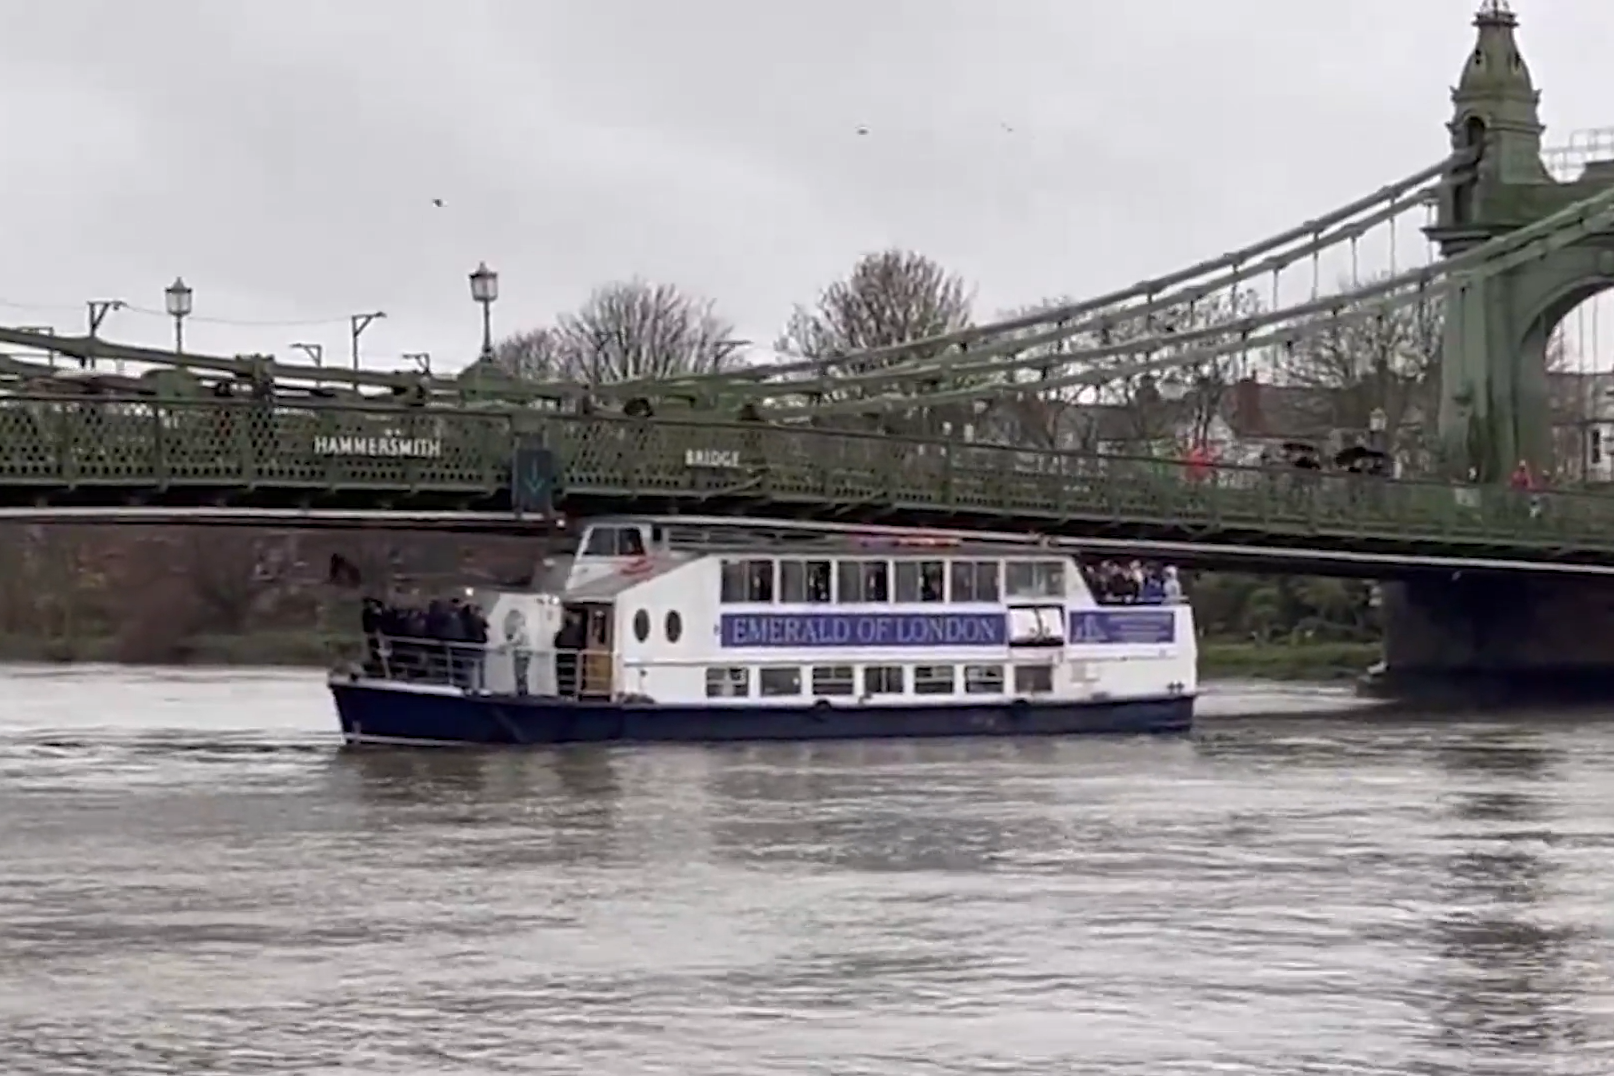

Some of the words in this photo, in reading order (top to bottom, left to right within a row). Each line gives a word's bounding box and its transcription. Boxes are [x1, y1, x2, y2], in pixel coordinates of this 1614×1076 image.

[313, 435, 441, 457] HAMMERSMITH
[685, 448, 740, 467] BRIDGE
[732, 617, 850, 643] EMERALD
[857, 617, 893, 642] OF
[896, 616, 998, 642] LONDON
